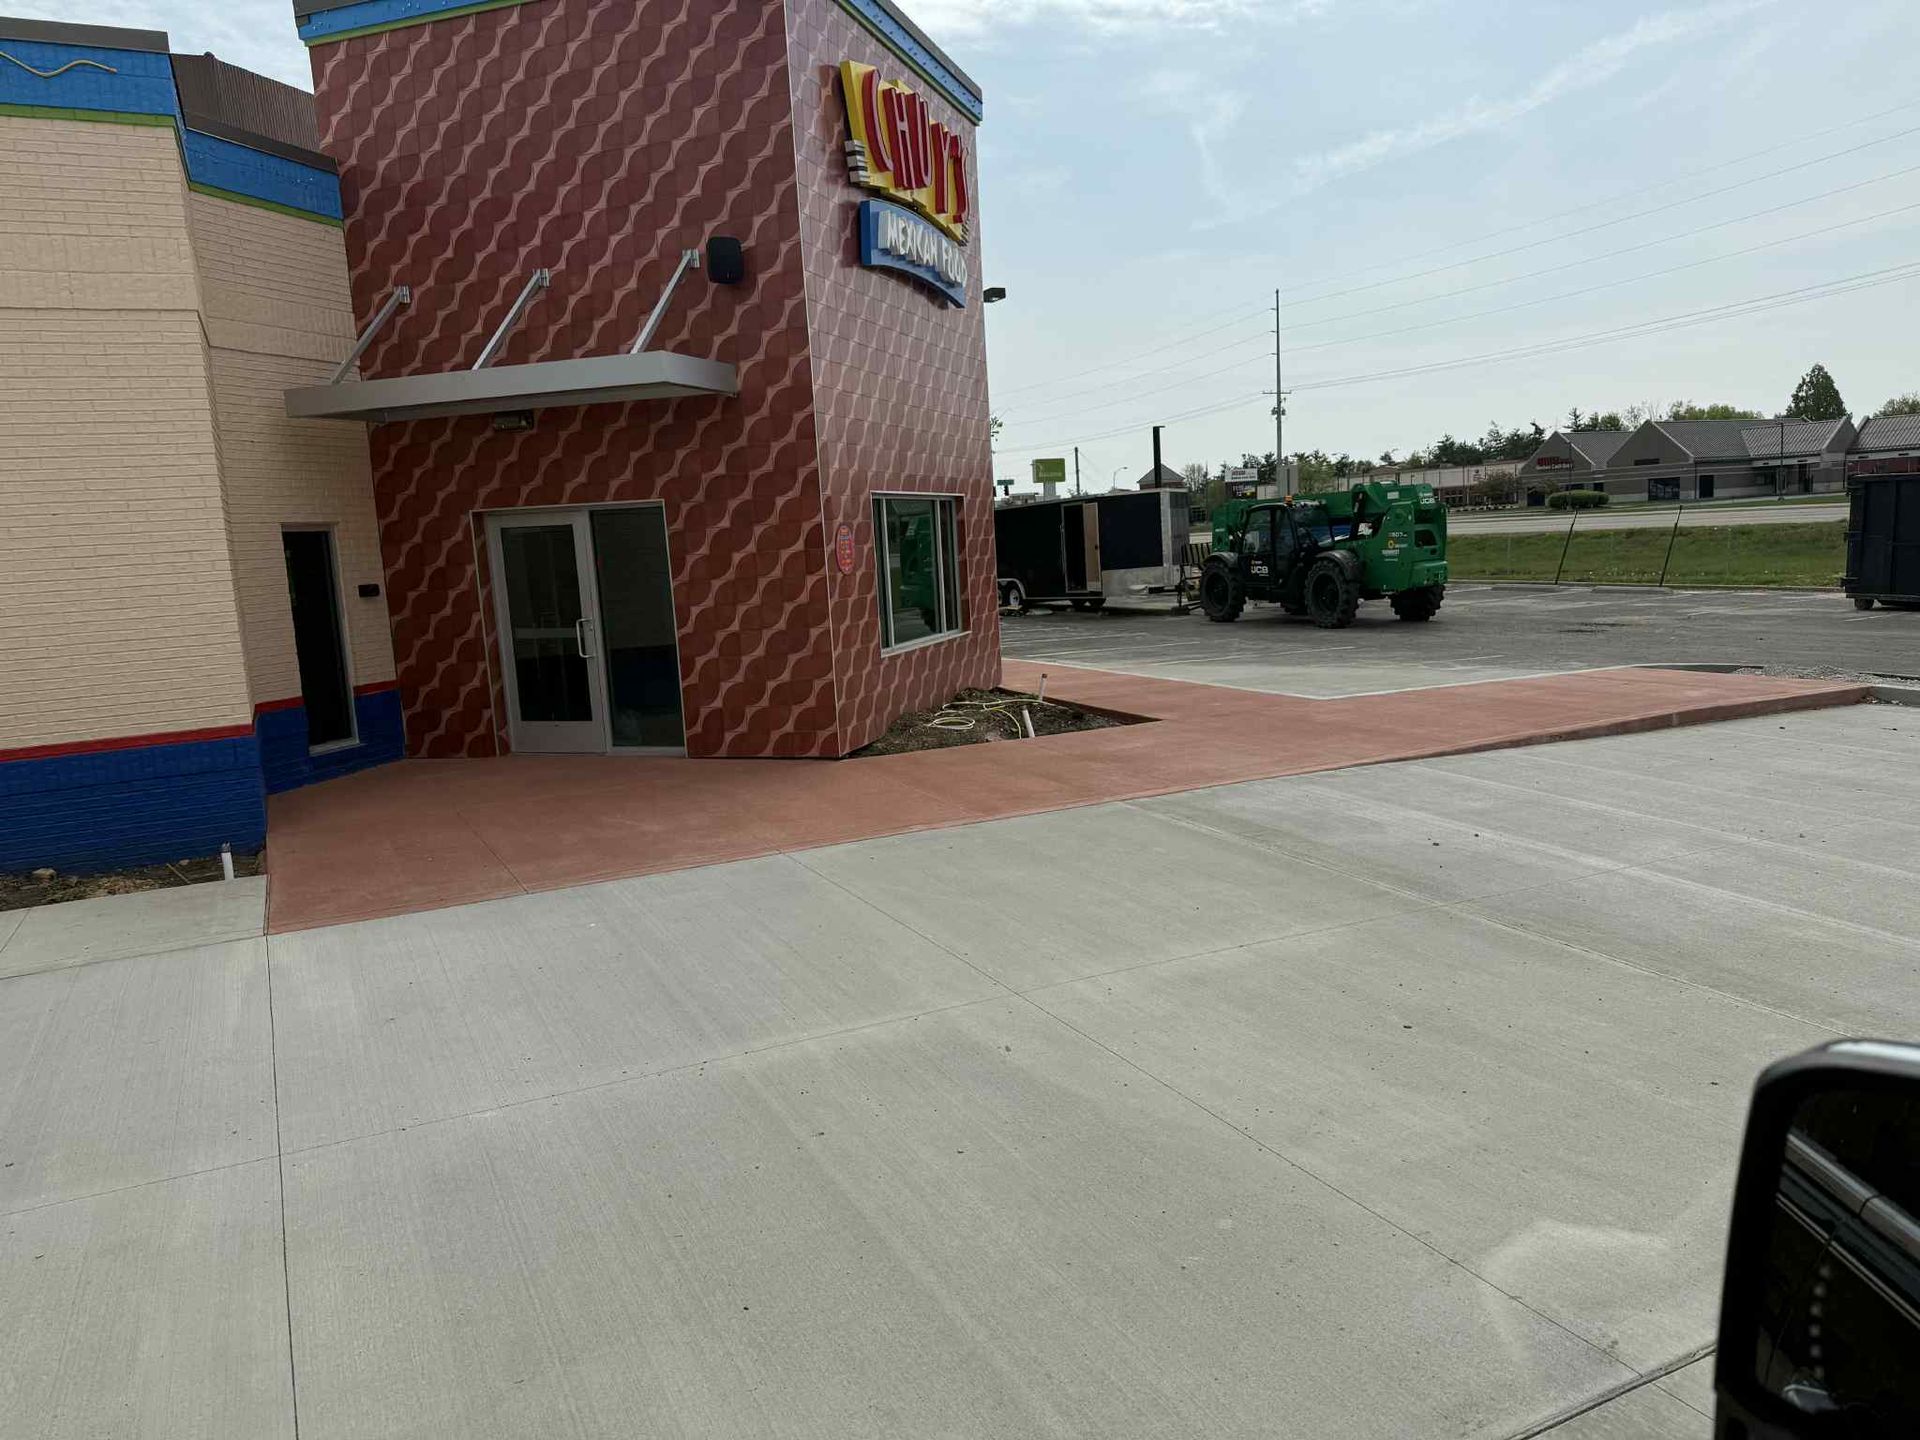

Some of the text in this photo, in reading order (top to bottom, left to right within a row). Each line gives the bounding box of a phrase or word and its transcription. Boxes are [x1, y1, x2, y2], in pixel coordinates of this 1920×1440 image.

[862, 69, 969, 223] CHUY'S
[879, 210, 968, 288] MEXICAN FOOD
[1419, 497, 1436, 505] JCB
[1250, 565, 1269, 574] JCB
